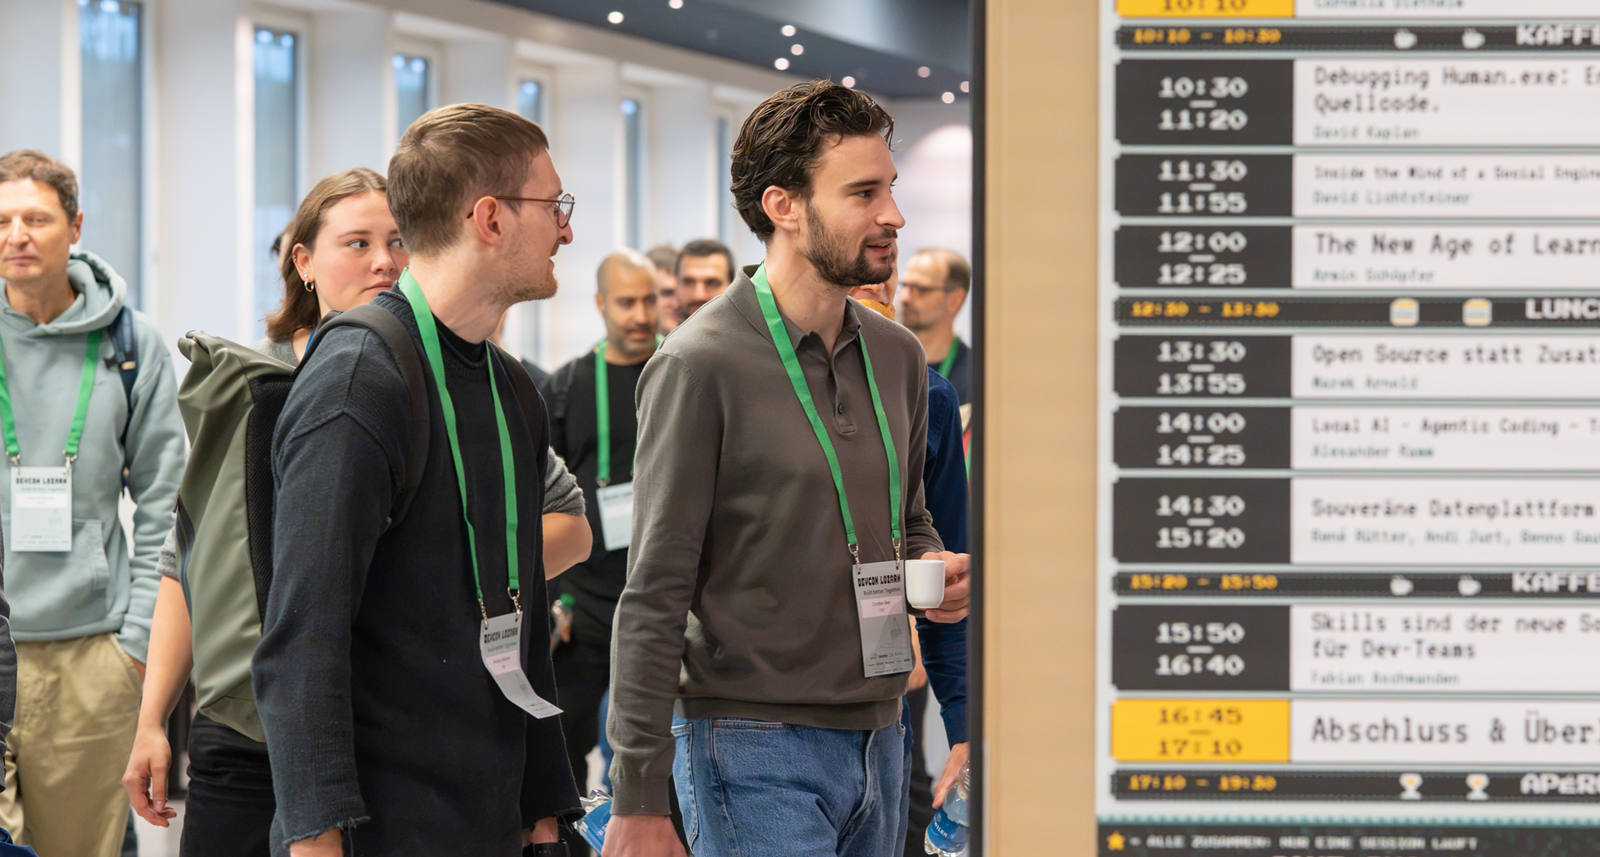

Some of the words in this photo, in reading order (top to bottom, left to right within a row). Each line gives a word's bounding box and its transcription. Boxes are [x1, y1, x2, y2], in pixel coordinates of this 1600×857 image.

[1160, 77, 1248, 97] 10:30
[1315, 66, 1429, 90] Debugging
[1443, 68, 1566, 85] Human.exe:
[1315, 93, 1438, 114] Quellcode.
[1159, 109, 1247, 130] 11:20
[1159, 161, 1247, 181] 11:30
[1375, 167, 1398, 178] the
[1159, 192, 1247, 213] 11:55
[1159, 232, 1246, 252] 12:00
[1316, 233, 1356, 254] The
[1373, 234, 1413, 253] New
[1430, 234, 1472, 260] Age
[1489, 234, 1514, 254] of
[1158, 264, 1246, 284] 12:25
[1526, 299, 1600, 319] LUNC
[1158, 341, 1246, 362] 13:30
[1313, 344, 1362, 366] Open
[1376, 344, 1448, 363] Source
[1464, 345, 1521, 363] statt
[1158, 373, 1246, 394] 13:55
[1158, 413, 1245, 433] 14:00
[1157, 444, 1245, 465] 14:25
[1157, 496, 1245, 516] 14:30
[1312, 499, 1417, 516] Souveräne
[1430, 499, 1594, 519] Datenplattform
[1157, 527, 1245, 548] 15:20
[1312, 612, 1386, 632] Skills
[1402, 615, 1451, 632] sind
[1466, 616, 1501, 632] der
[1516, 619, 1566, 632] neue
[1156, 623, 1245, 643] 15:50
[1313, 639, 1348, 658] für
[1363, 639, 1475, 658] Dev-Teams
[1156, 654, 1244, 675] 16:40
[1160, 708, 1242, 724] 16:45
[1312, 717, 1468, 743] Abschluss
[1489, 718, 1504, 743] &
[1525, 710, 1600, 744] Über
[1160, 739, 1242, 756] 17:10
